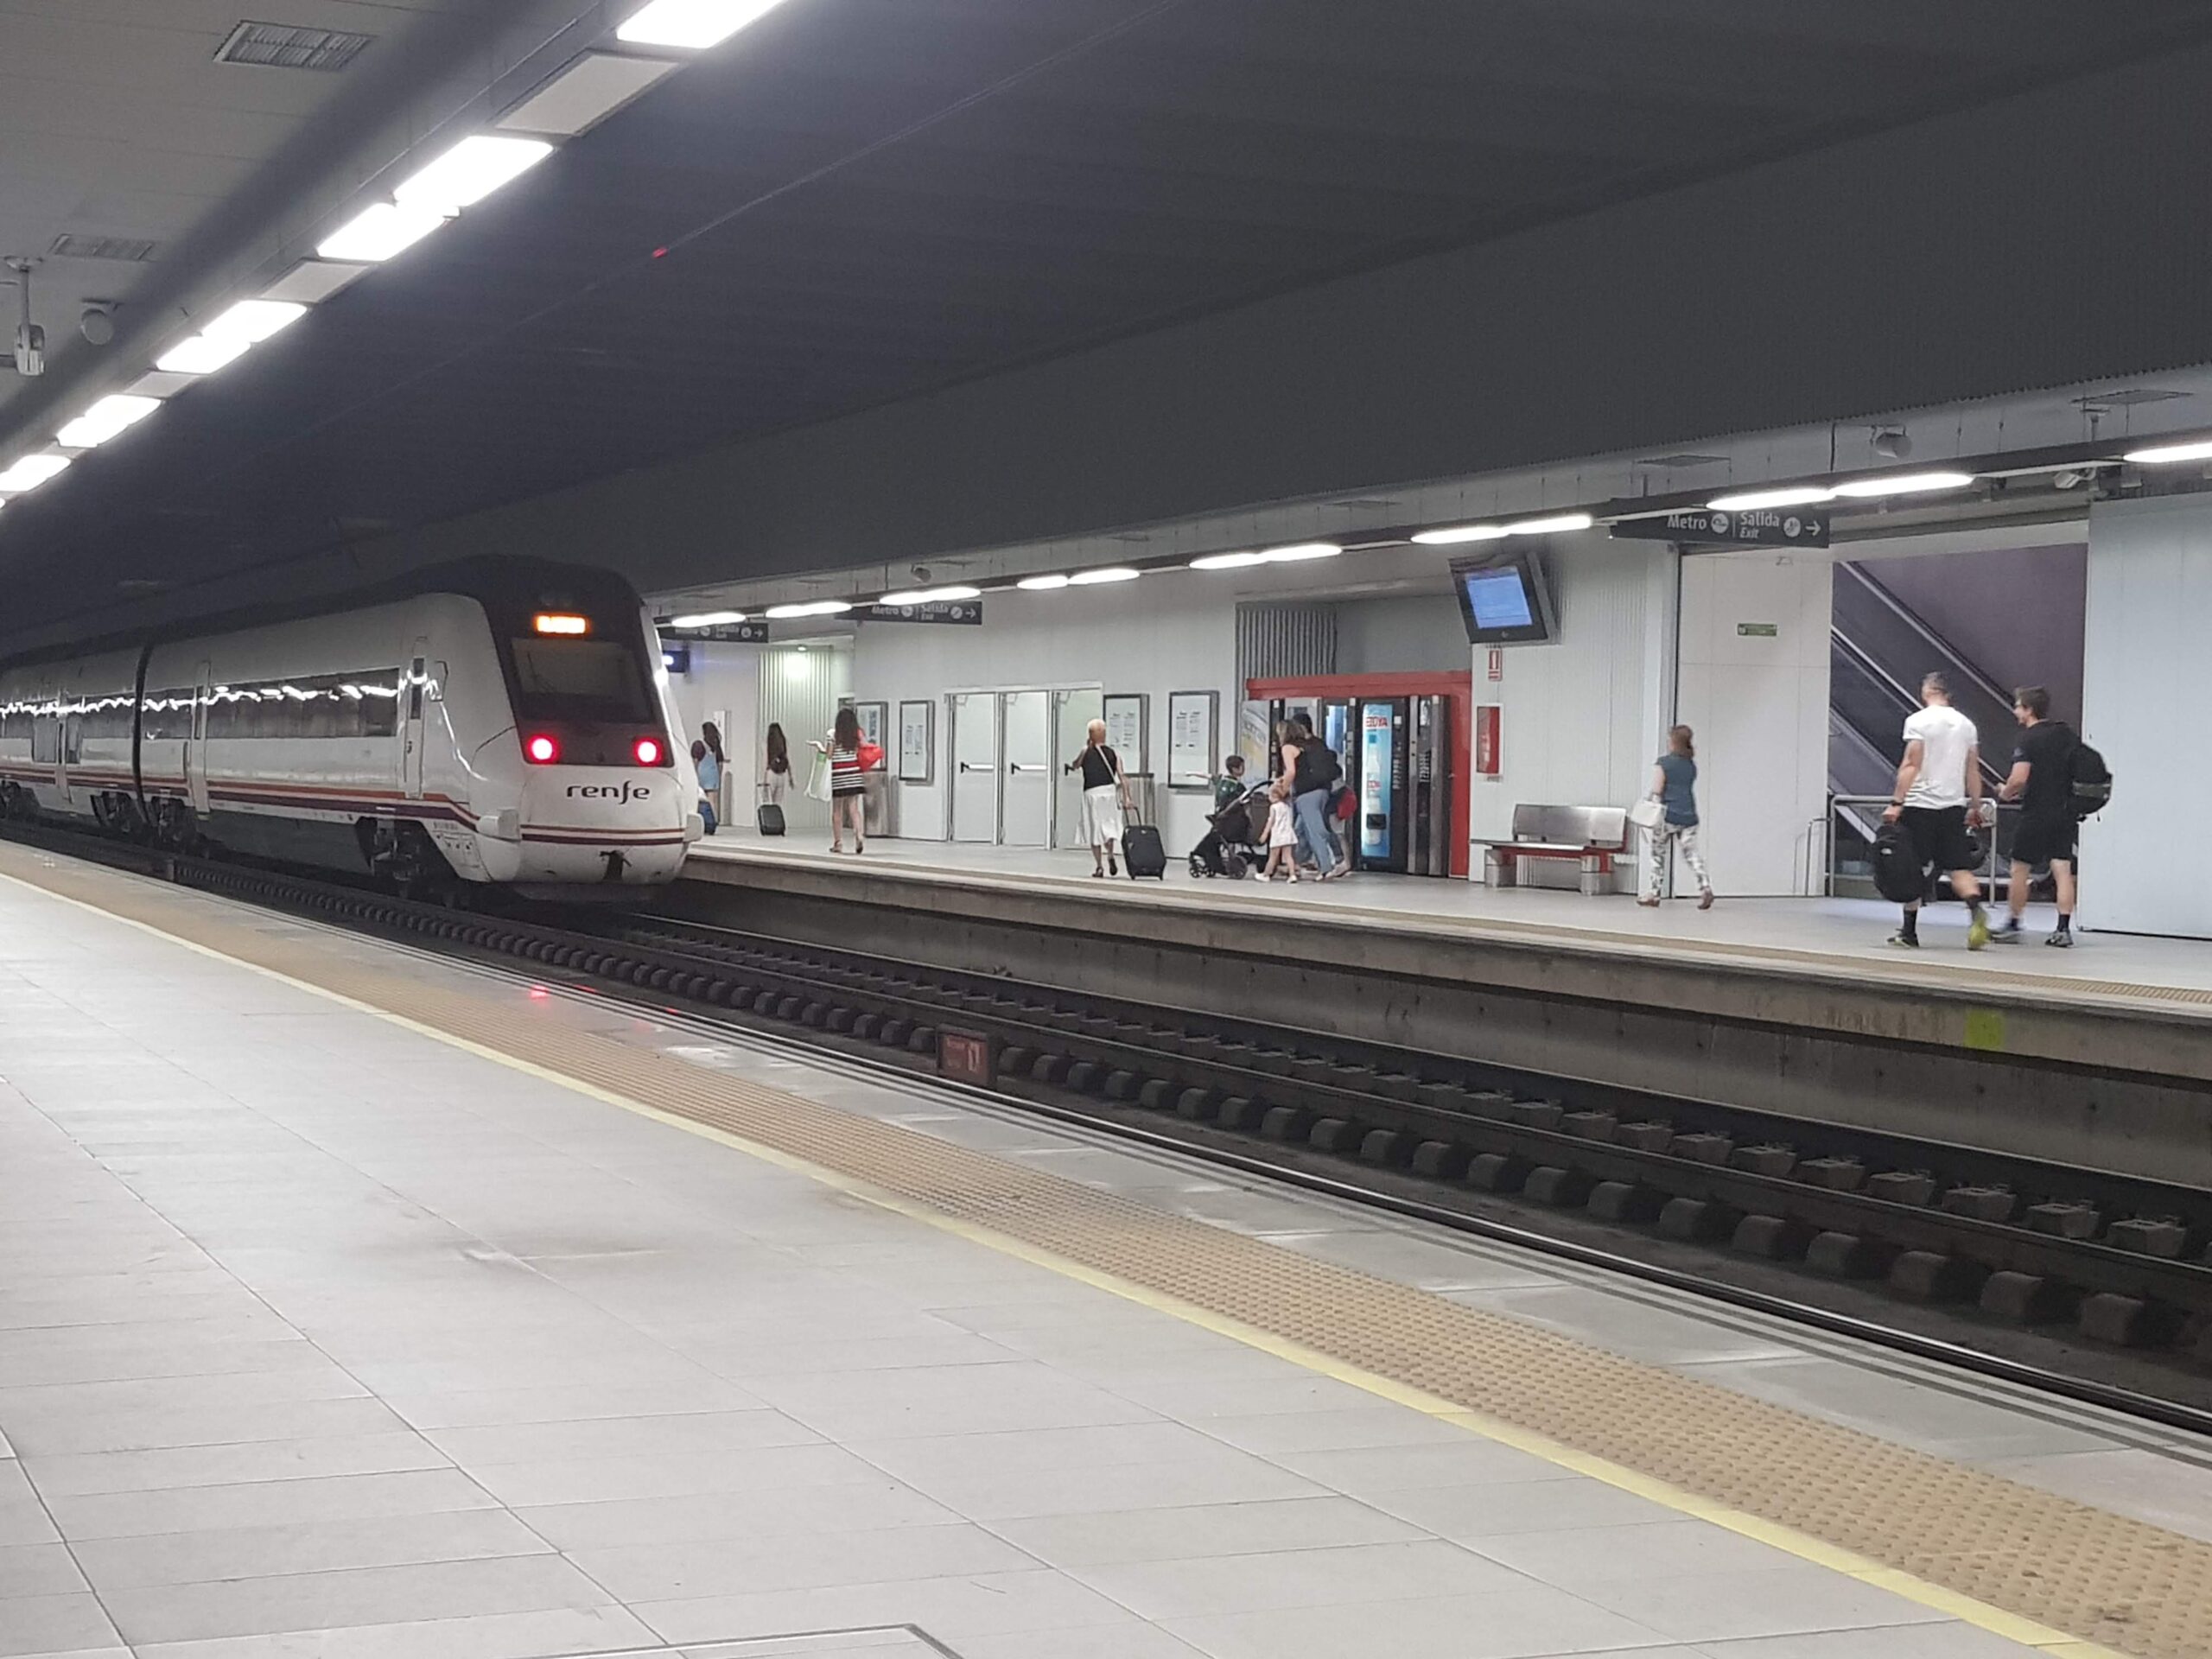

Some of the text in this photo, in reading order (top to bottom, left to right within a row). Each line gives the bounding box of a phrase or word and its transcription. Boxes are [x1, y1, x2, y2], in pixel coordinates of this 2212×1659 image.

[1667, 514, 1707, 531] Metro
[1739, 512, 1780, 527] Salida
[1739, 526, 1759, 538] Exit
[566, 779, 651, 805] renfe
